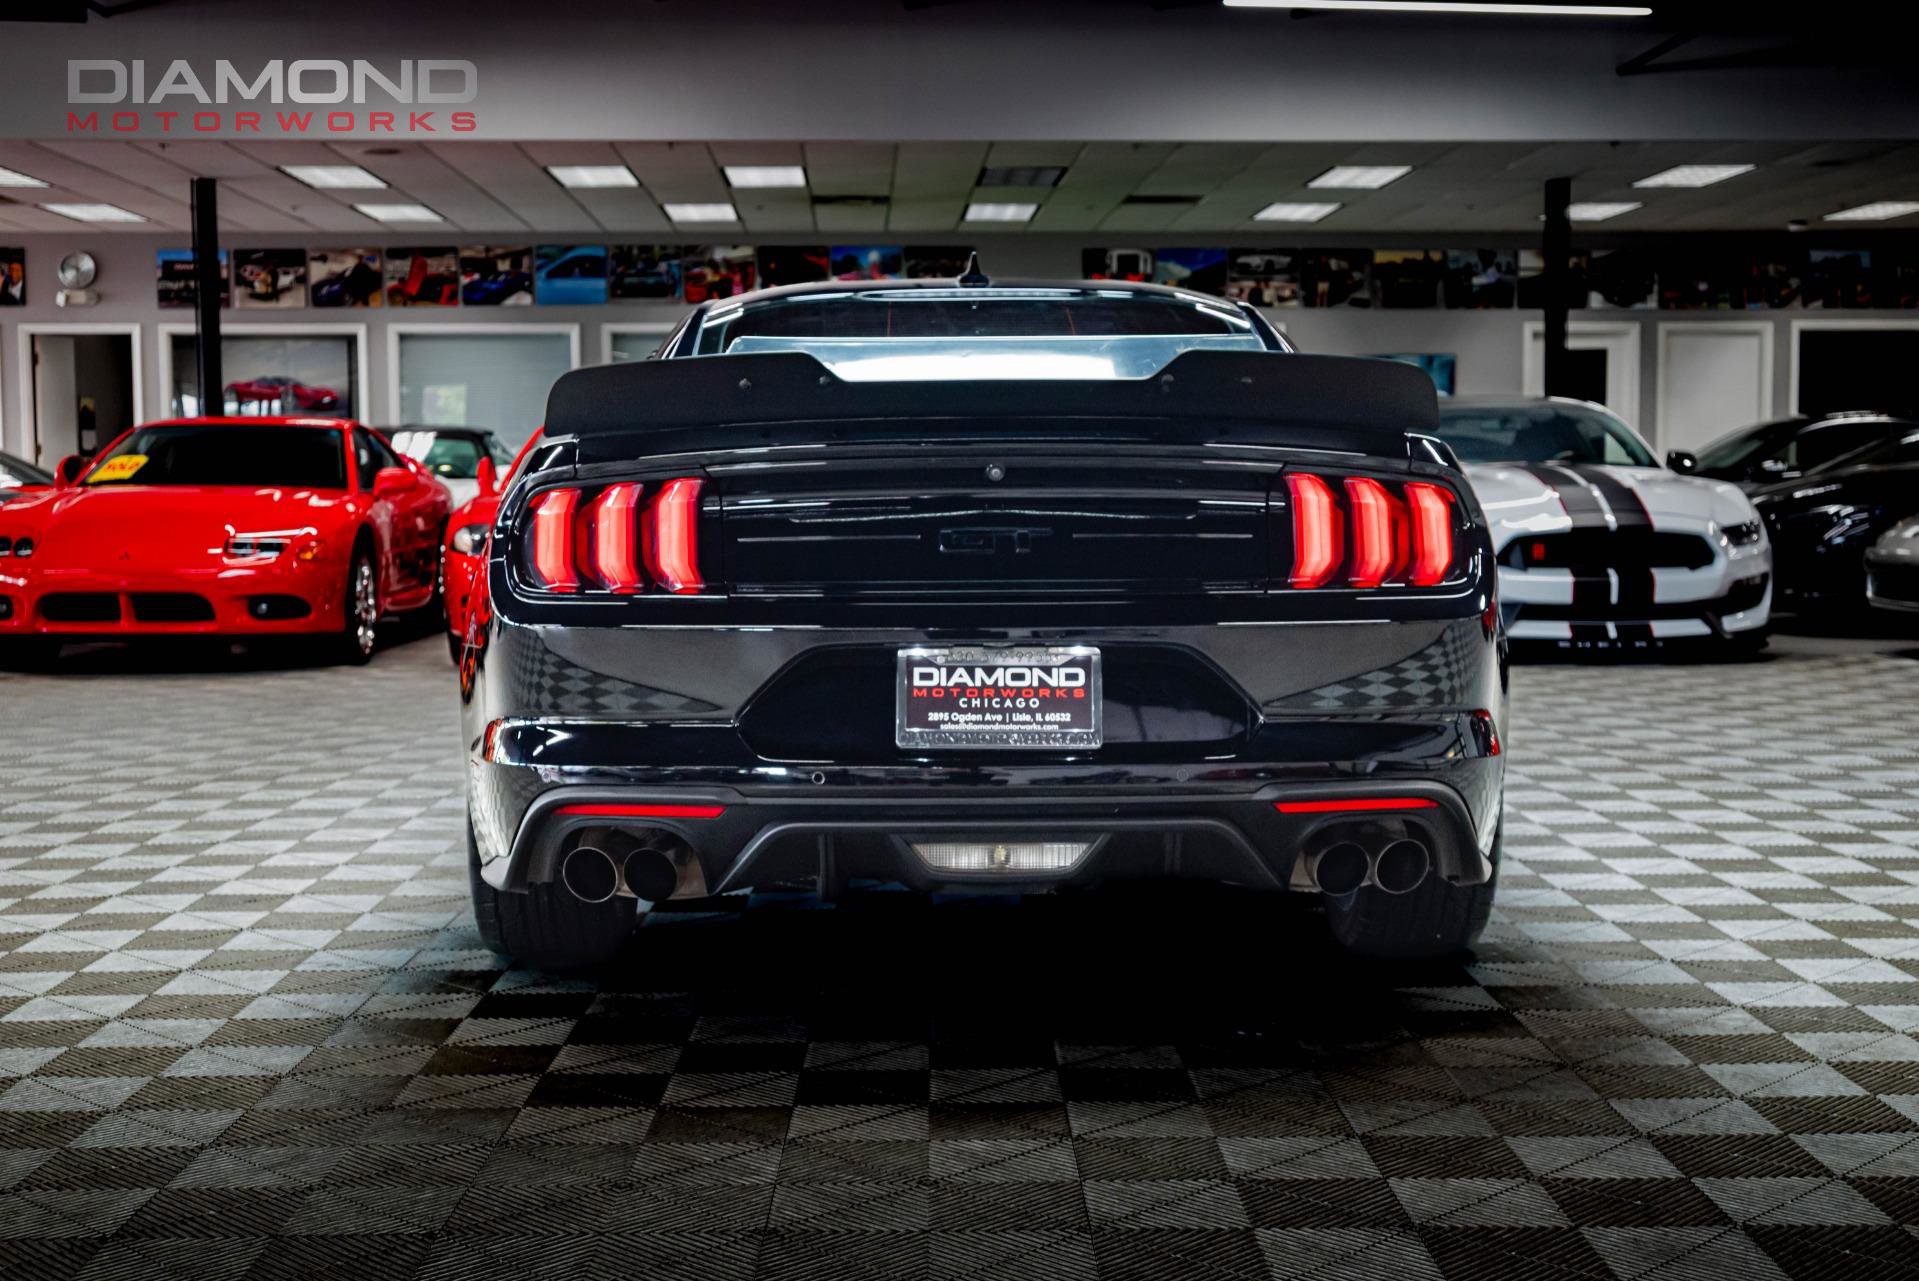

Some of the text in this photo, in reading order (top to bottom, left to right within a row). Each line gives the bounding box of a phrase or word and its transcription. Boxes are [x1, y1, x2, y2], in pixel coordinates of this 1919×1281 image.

[912, 667, 1086, 687] DIAMOND
[912, 687, 1086, 698] MOTORWORKS
[958, 697, 1040, 708] CHICAGO
[928, 712, 949, 722] 2895
[951, 712, 982, 723] Ogden
[985, 712, 1003, 722] Ave
[1012, 712, 1034, 723] Lisle,
[1035, 712, 1043, 722] IL
[1044, 712, 1071, 722] 60532
[940, 722, 1059, 731] sales@diamondmotorworks.com
